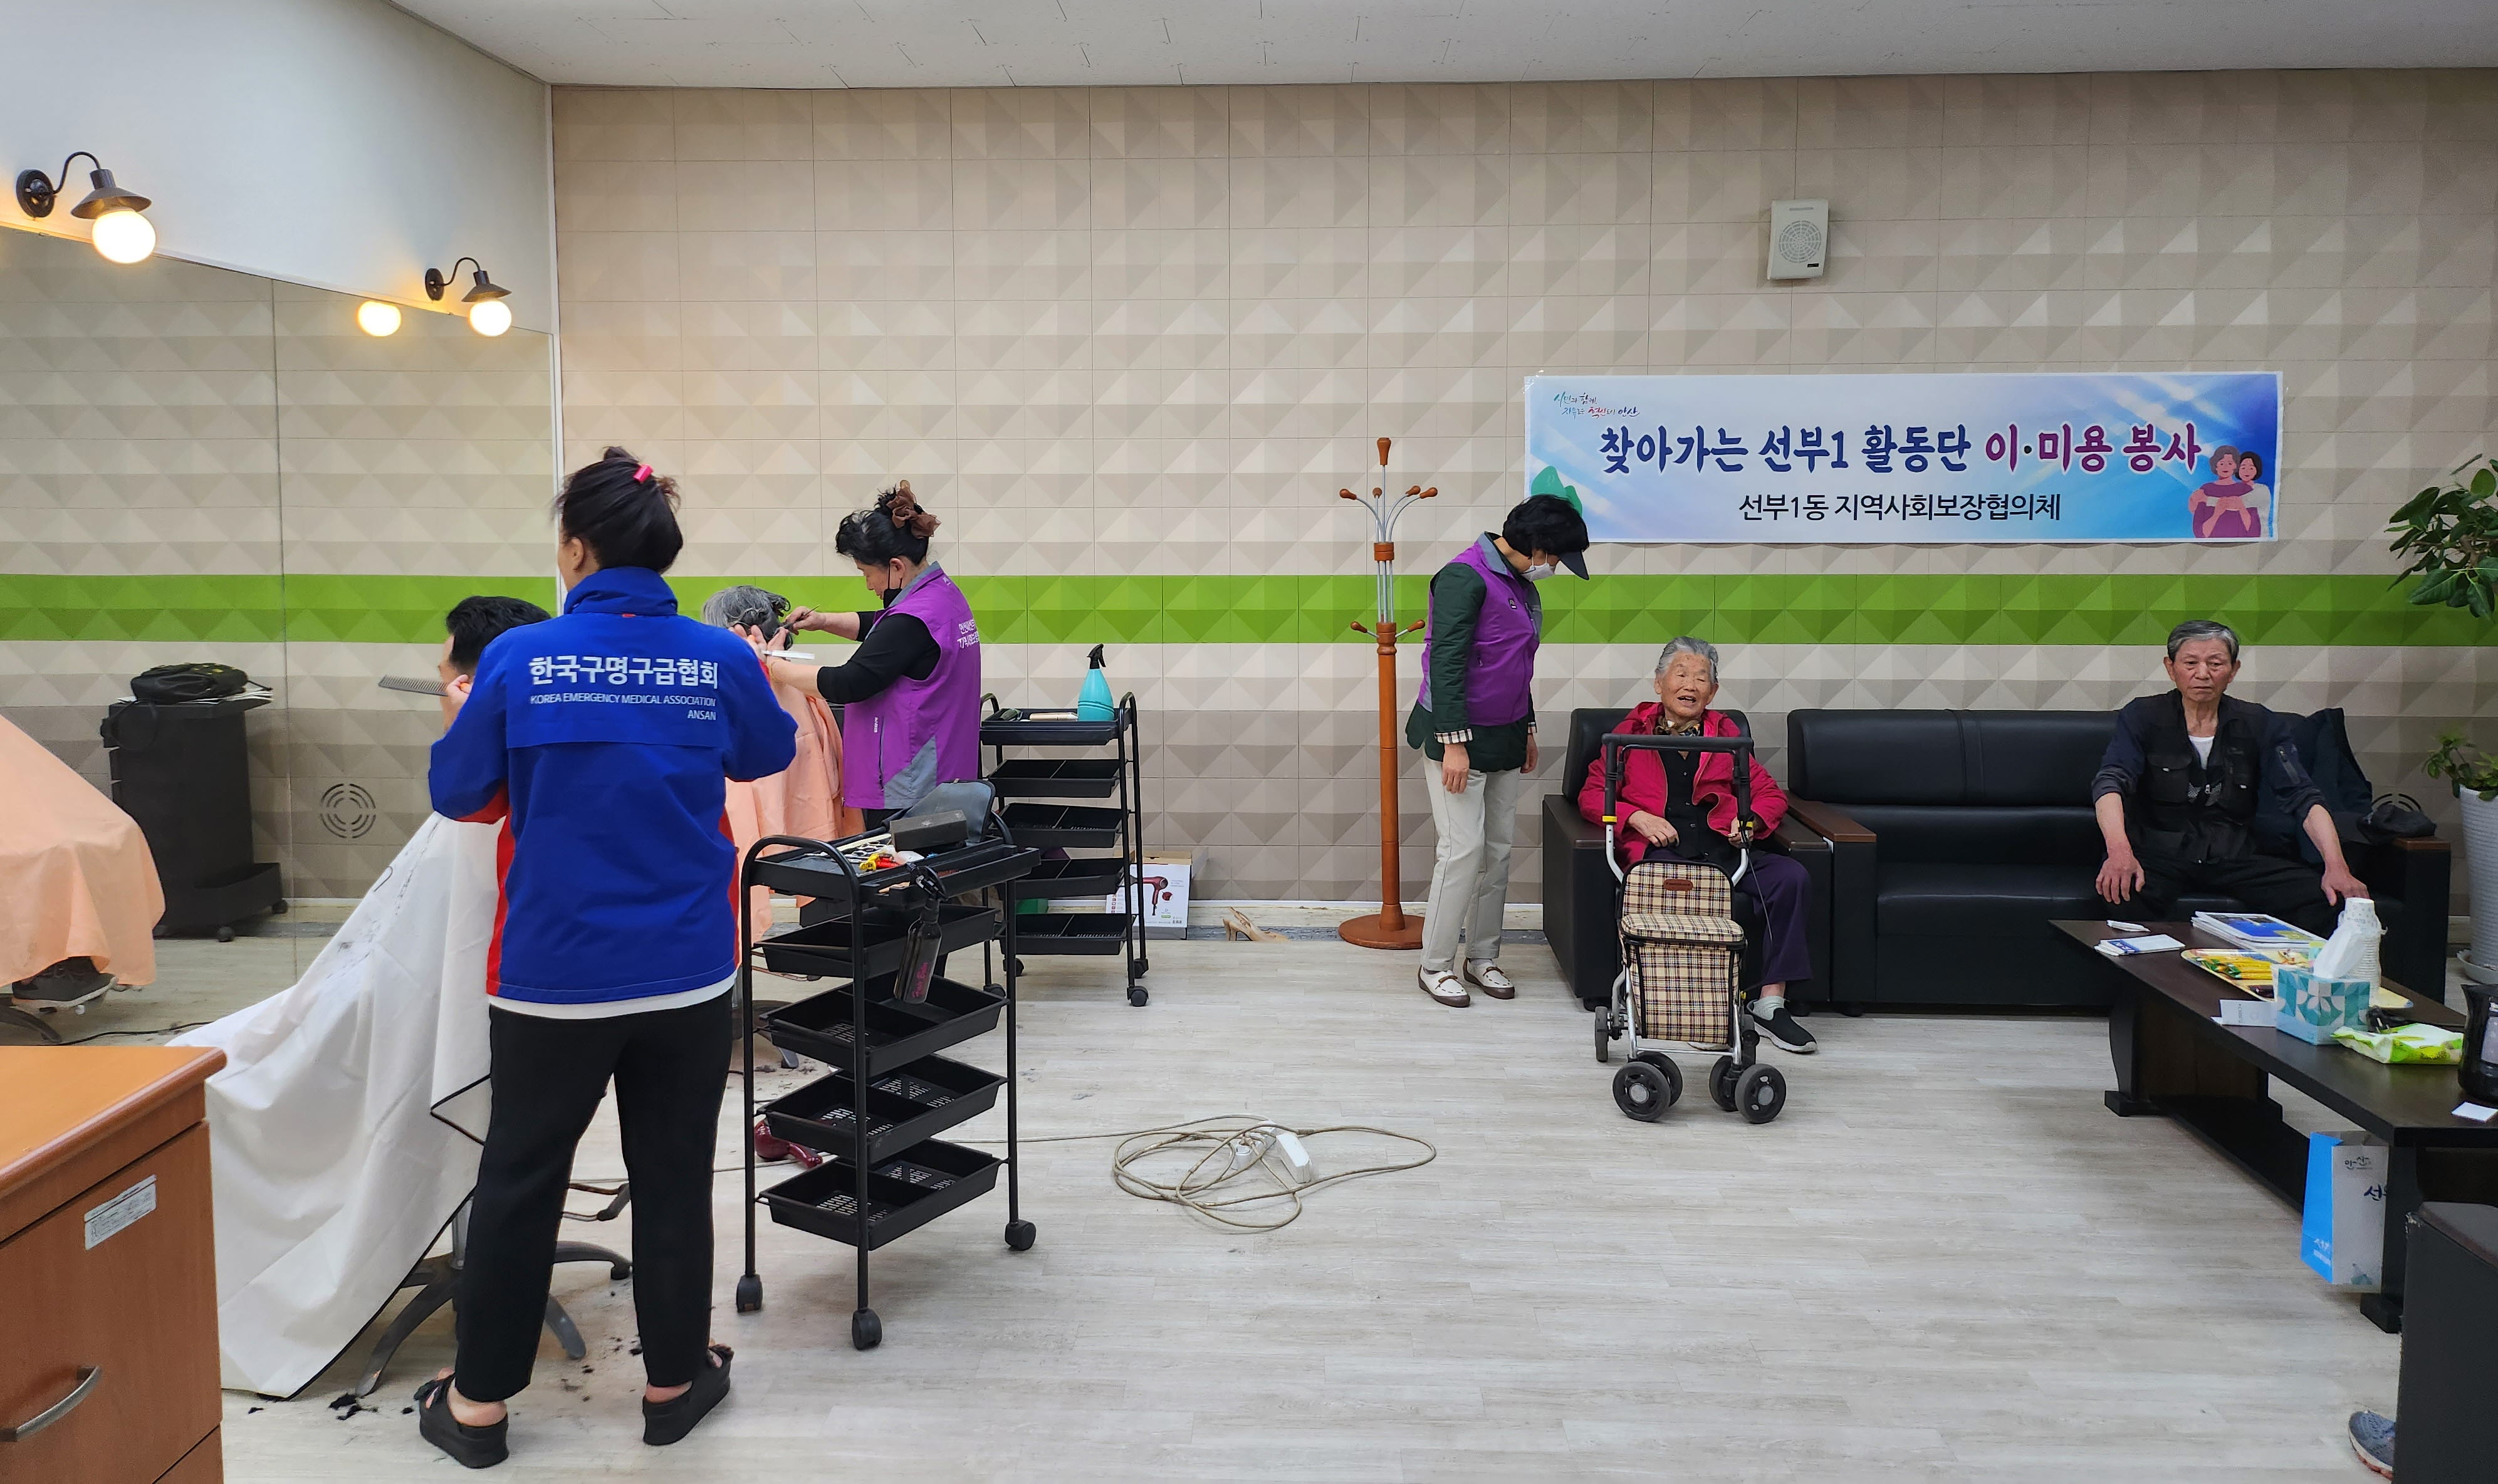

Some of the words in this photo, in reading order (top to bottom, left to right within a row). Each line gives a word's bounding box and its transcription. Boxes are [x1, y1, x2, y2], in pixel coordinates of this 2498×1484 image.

[1554, 391, 1577, 407] 시민과
[1561, 407, 1586, 420] 자유로운
[1587, 406, 1616, 419] 혁신도시
[1617, 406, 1641, 417] 안산
[1599, 424, 1749, 474] 찾아가는
[1757, 424, 1850, 474] 선부1
[1861, 424, 1972, 473] 활동단
[2123, 422, 2202, 473] 봉사
[1738, 494, 1829, 521] 선부1동
[1834, 493, 2061, 521] 지역사회보장협의체
[528, 655, 719, 689] 한국구명구급협회
[530, 694, 562, 704] KOREA
[563, 692, 621, 704] EMERGENCY
[621, 694, 662, 704] MEDICAL
[663, 695, 716, 707] ASSOCIATION
[687, 709, 716, 721] ANSAN
